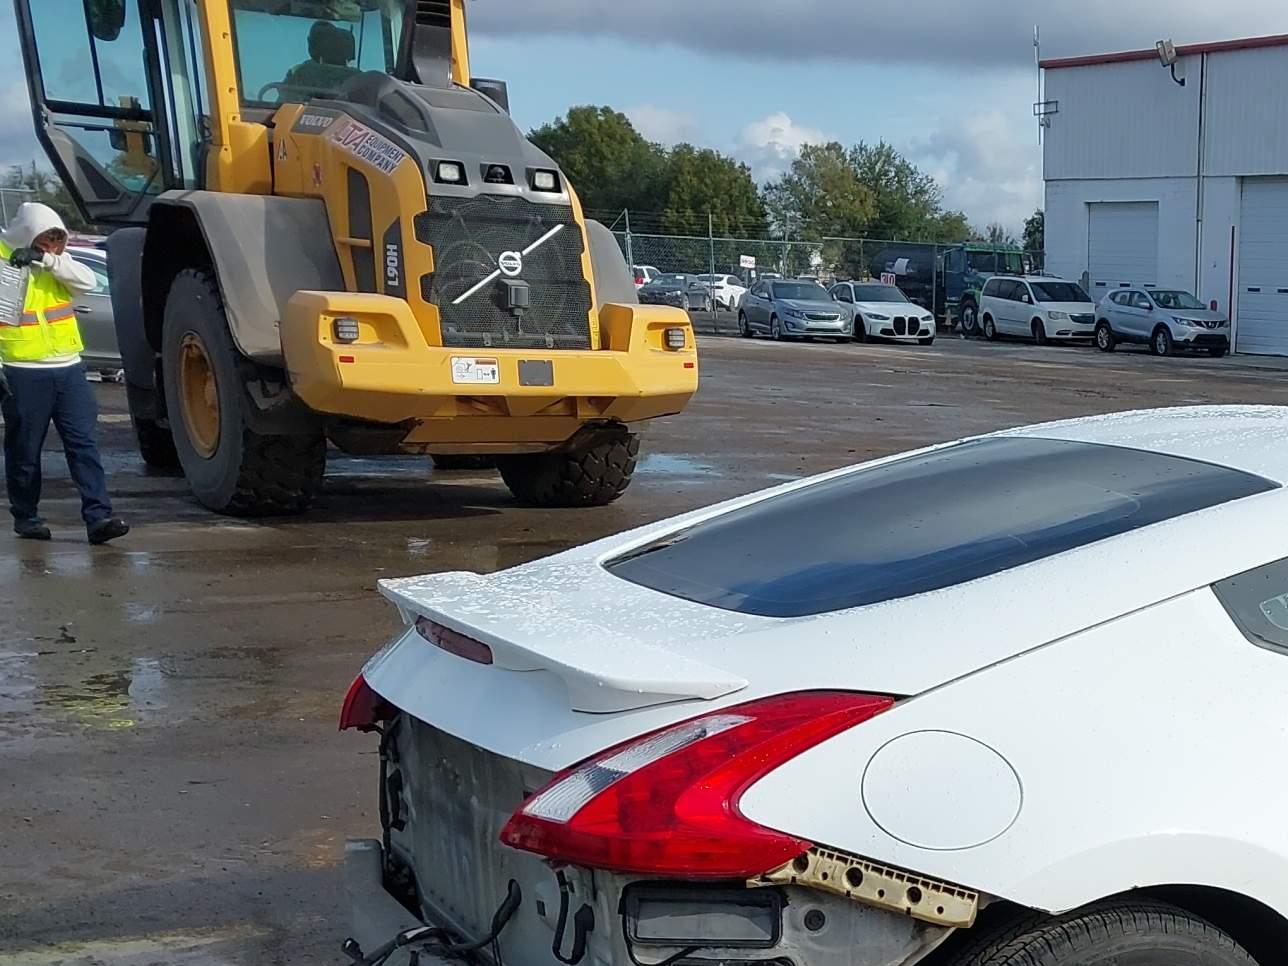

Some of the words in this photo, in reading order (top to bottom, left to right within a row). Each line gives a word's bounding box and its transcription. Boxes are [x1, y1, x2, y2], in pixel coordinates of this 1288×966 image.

[358, 145, 395, 174] COMPANY
[366, 135, 405, 164] EQUIPMENT
[387, 244, 399, 286] L90H
